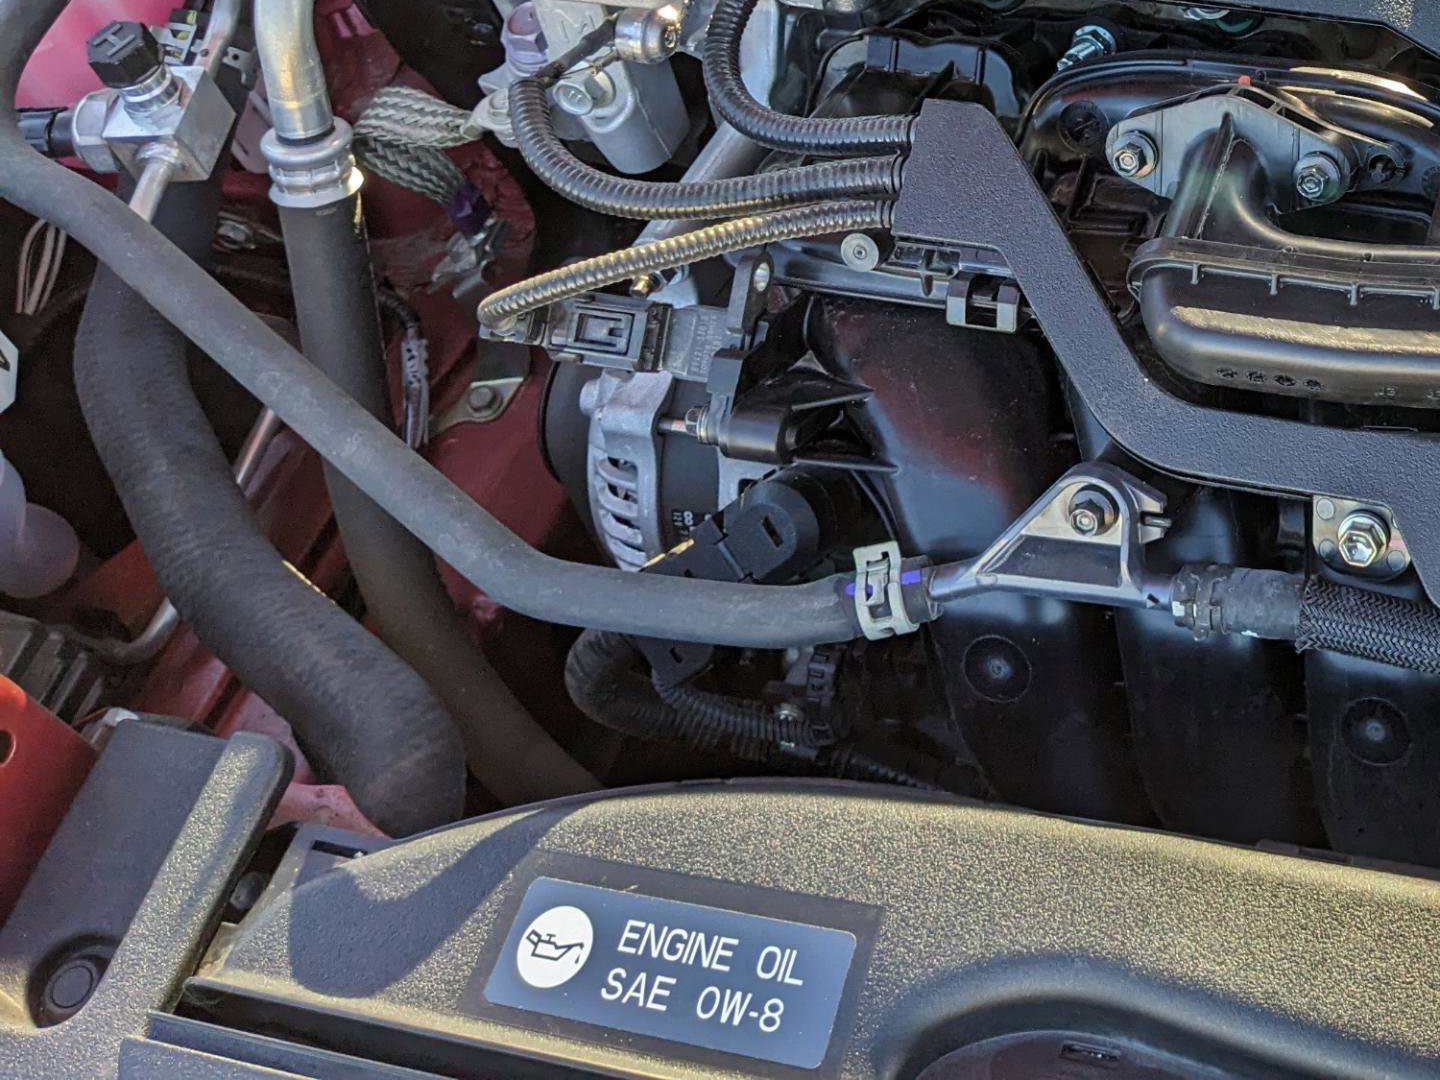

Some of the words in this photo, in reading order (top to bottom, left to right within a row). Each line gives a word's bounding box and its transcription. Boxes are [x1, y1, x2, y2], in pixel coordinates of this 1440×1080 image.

[92, 23, 136, 57] H
[616, 918, 740, 972] ENGINE
[756, 945, 804, 987] OIL
[600, 967, 678, 1012] SAE
[696, 985, 785, 1033] 0W-8
